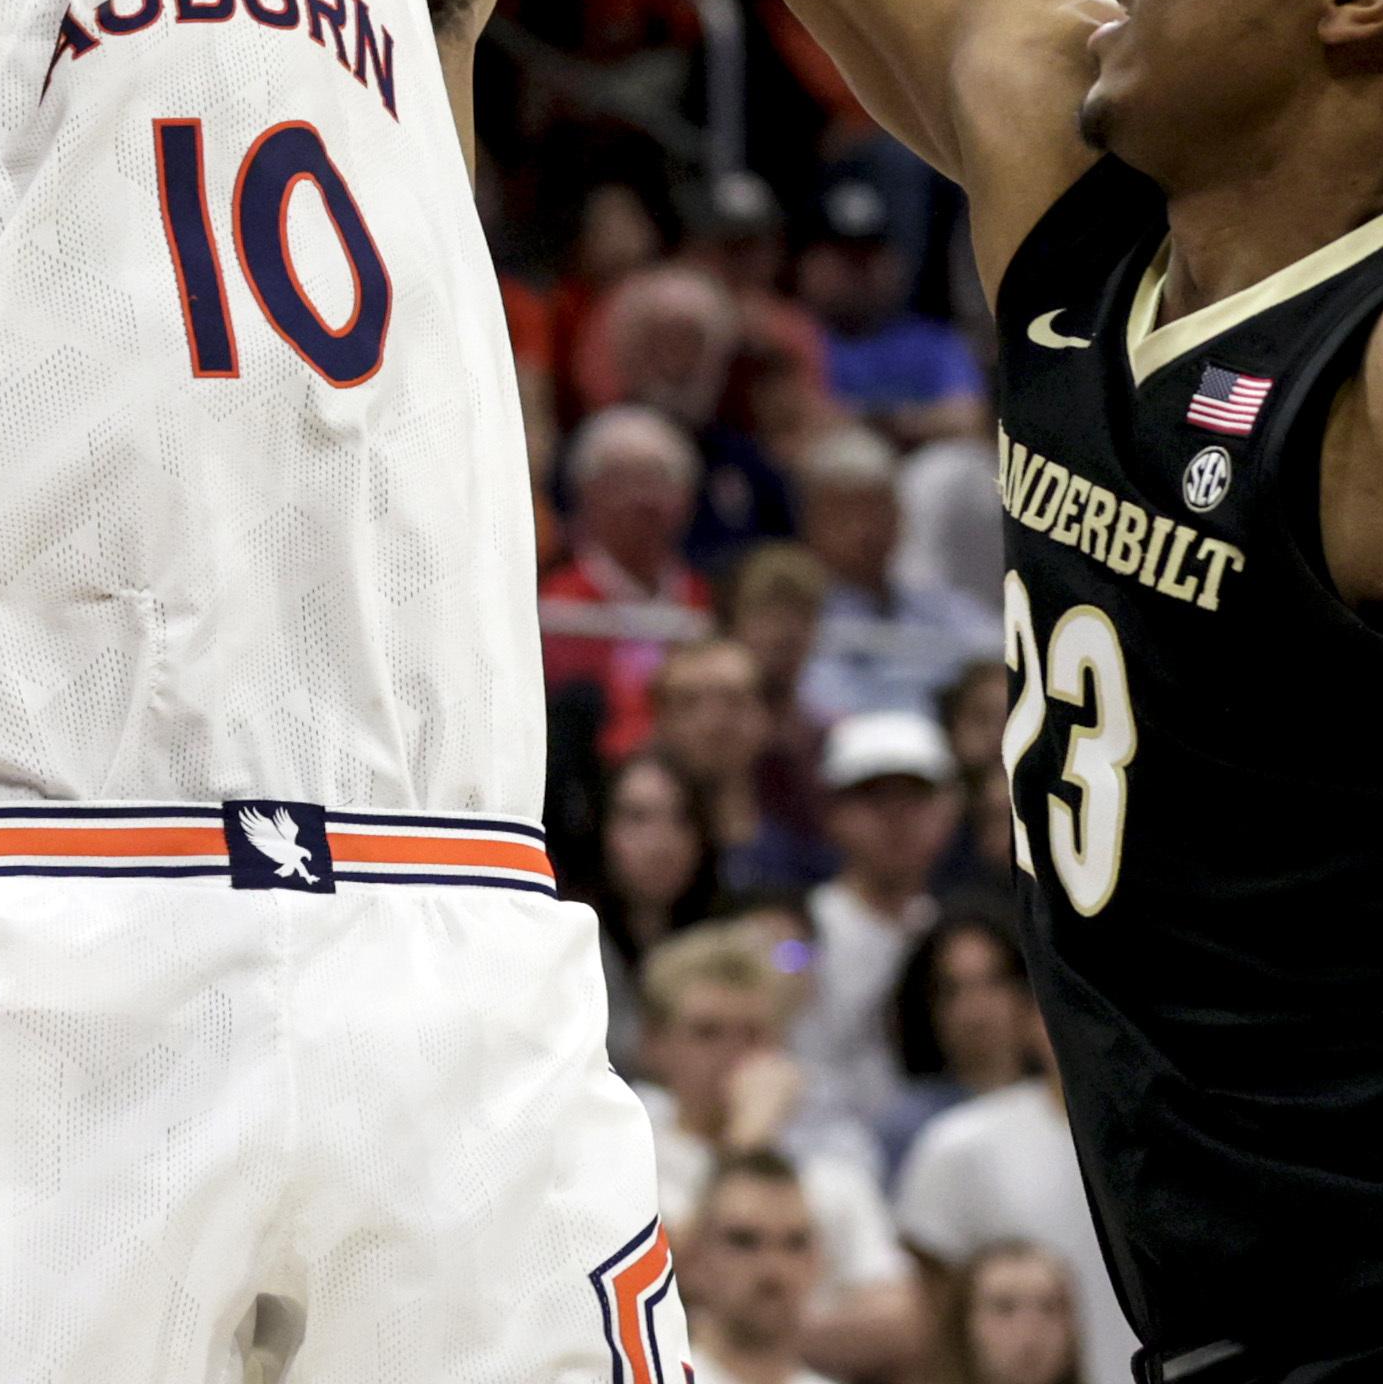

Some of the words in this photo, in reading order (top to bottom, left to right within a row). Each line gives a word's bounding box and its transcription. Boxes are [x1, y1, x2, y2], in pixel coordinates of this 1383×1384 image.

[152, 118, 392, 389] 10
[995, 418, 1246, 613] ANDERBILT
[1185, 449, 1227, 508] SEC
[1001, 569, 1138, 917] 23
